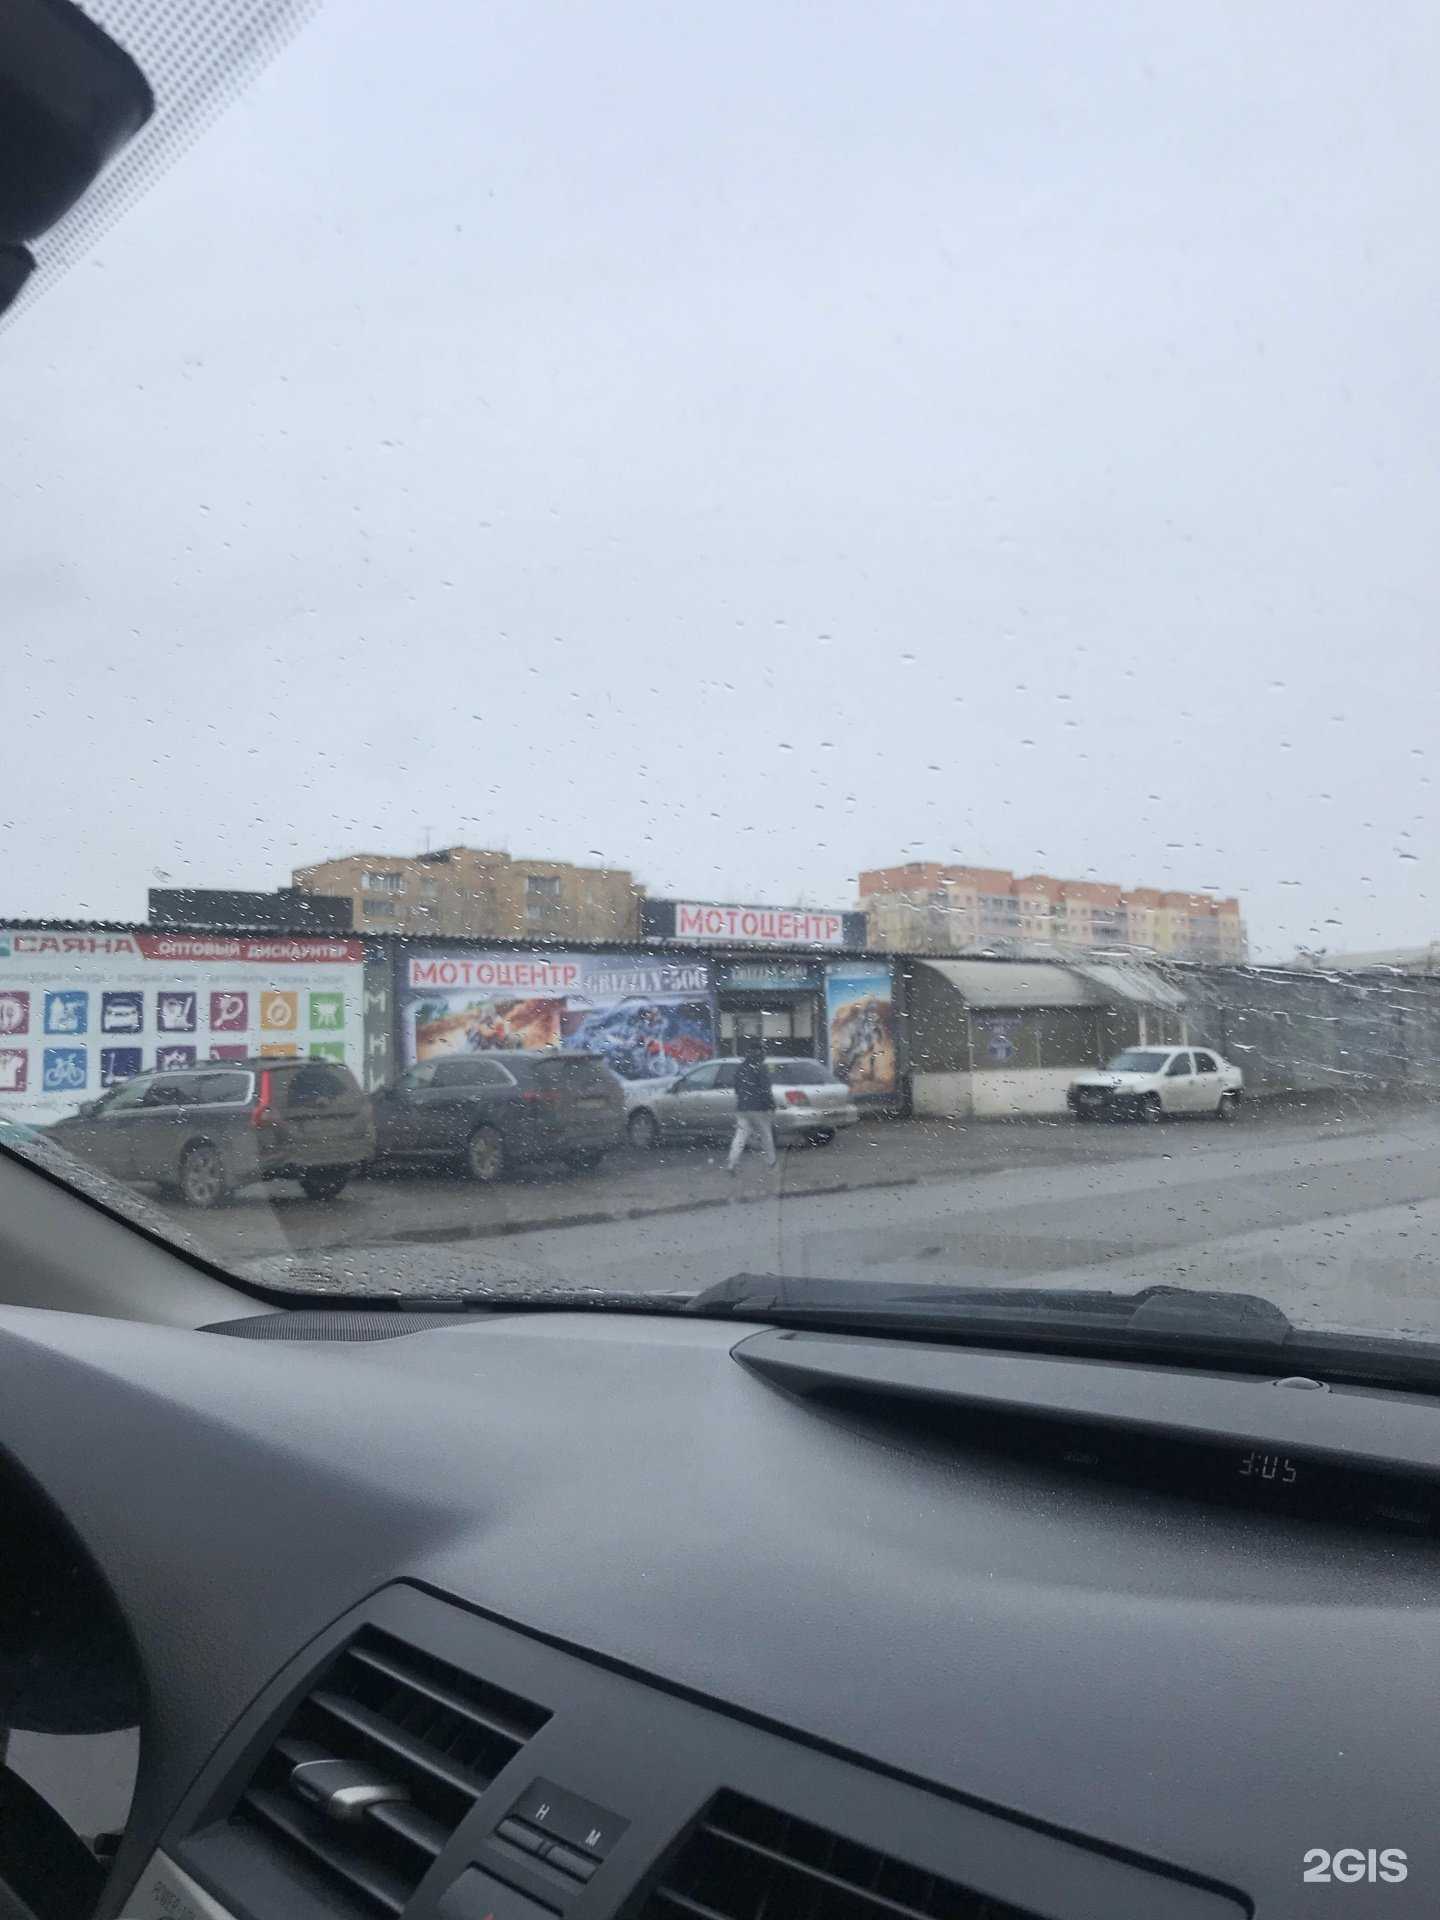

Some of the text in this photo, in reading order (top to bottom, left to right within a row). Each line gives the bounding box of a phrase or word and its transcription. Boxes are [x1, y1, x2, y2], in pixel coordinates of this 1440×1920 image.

[680, 907, 840, 940] МОТОЦЕНТР
[14, 935, 134, 954] САЯНА
[412, 960, 578, 987] МОТОЦЕНТР
[1239, 1451, 1297, 1483] 3:05
[535, 1803, 551, 1821] H
[585, 1828, 602, 1848] M
